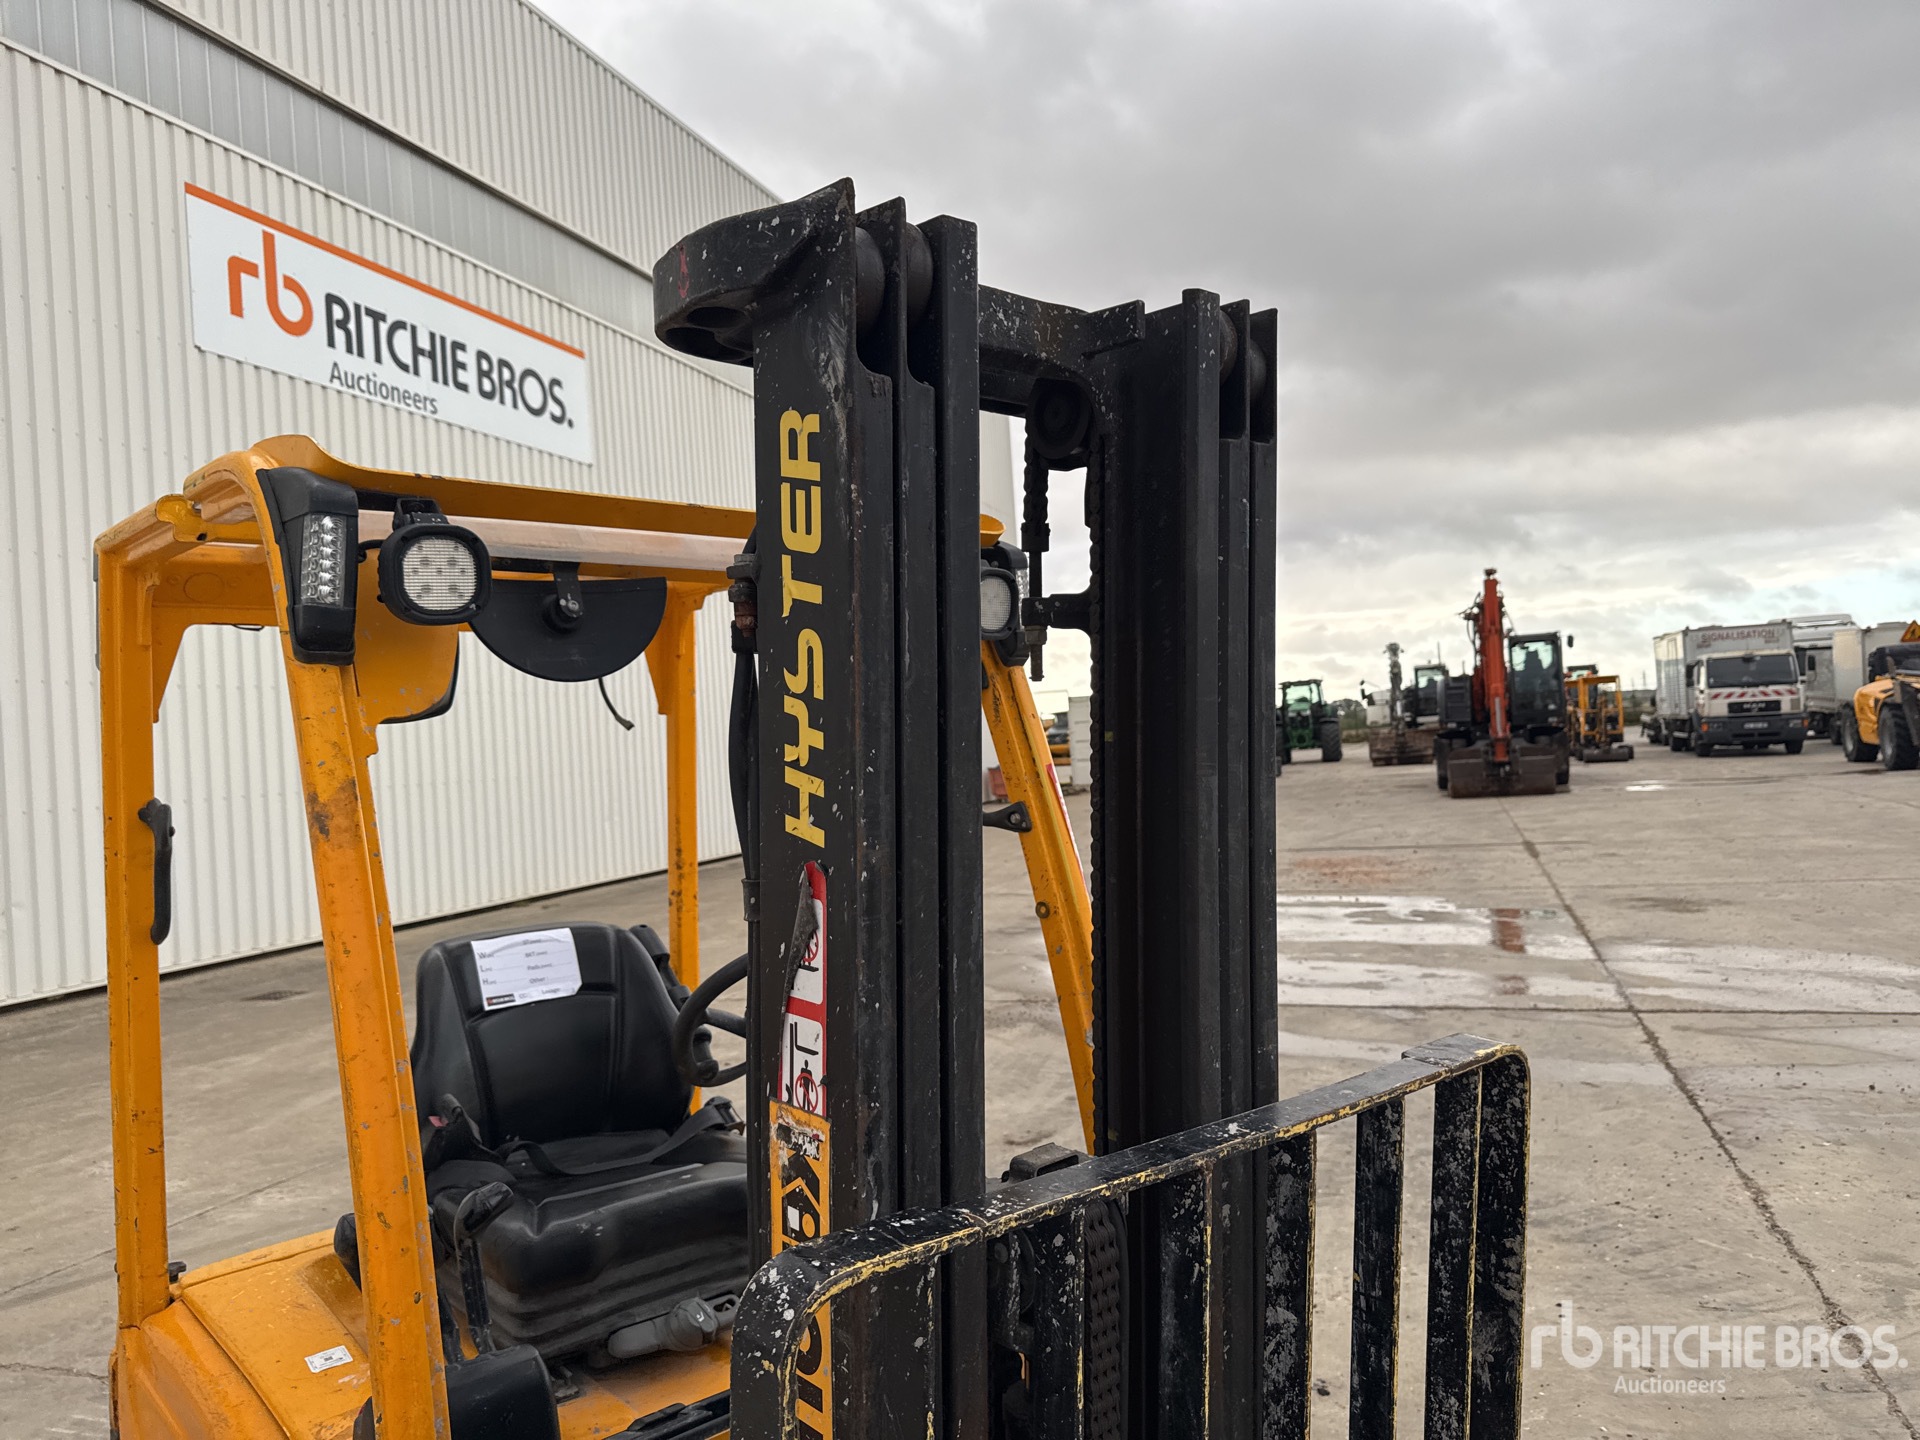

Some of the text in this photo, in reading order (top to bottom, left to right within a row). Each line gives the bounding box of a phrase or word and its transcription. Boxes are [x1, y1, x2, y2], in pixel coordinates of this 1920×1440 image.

[227, 229, 575, 429] rb RITCHIE BROS.
[329, 361, 439, 415] Auctioneers
[779, 409, 825, 848] HYSTER
[1701, 628, 1775, 642] SIGNALISATION
